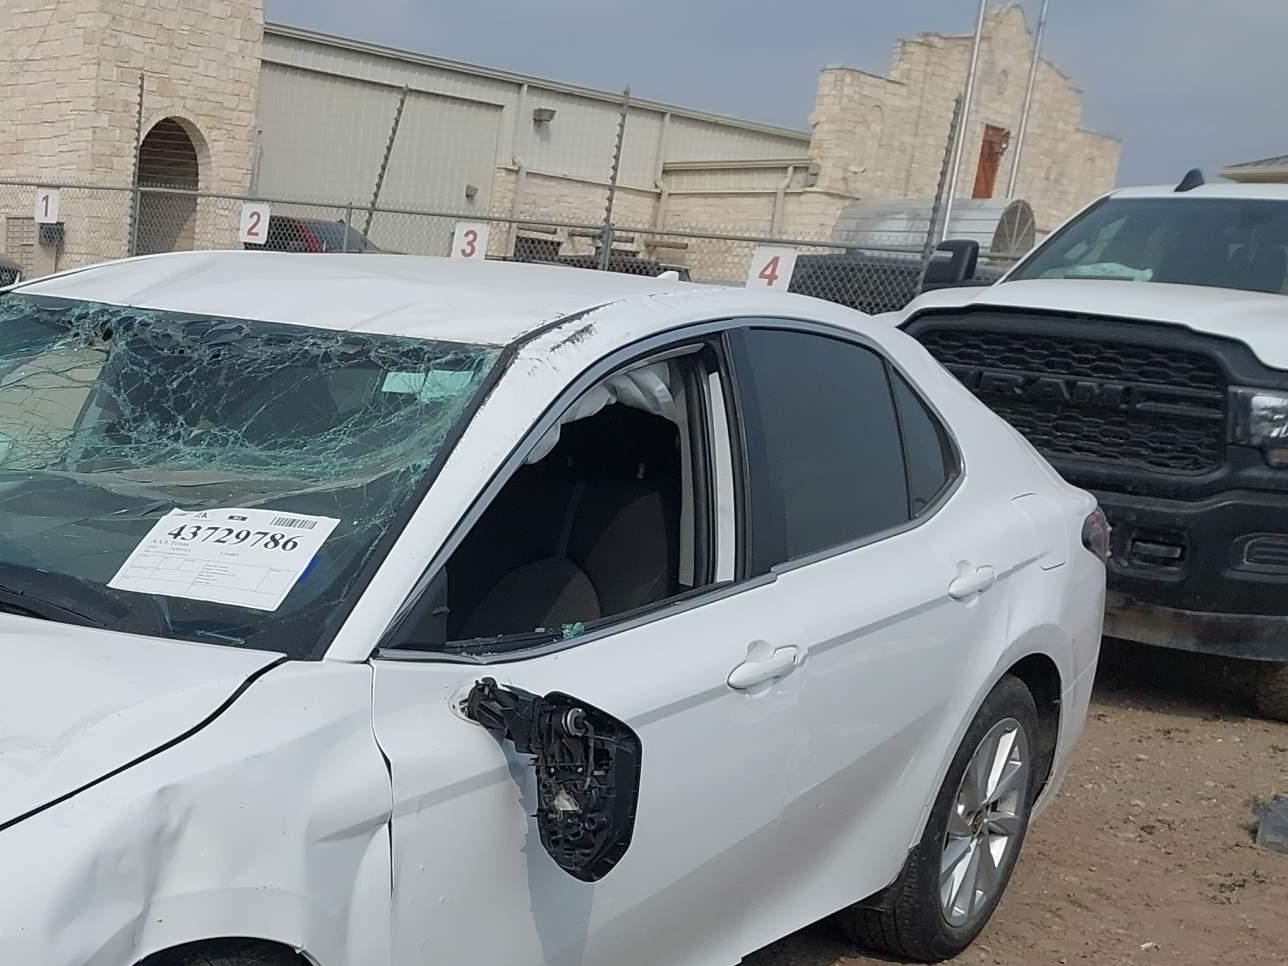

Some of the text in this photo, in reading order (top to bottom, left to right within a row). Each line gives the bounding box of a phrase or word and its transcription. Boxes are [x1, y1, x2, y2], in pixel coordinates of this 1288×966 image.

[41, 194, 50, 218] 1
[246, 211, 262, 237] 2
[460, 229, 479, 258] 3
[758, 255, 782, 287] 4
[167, 523, 305, 553] 43729786
